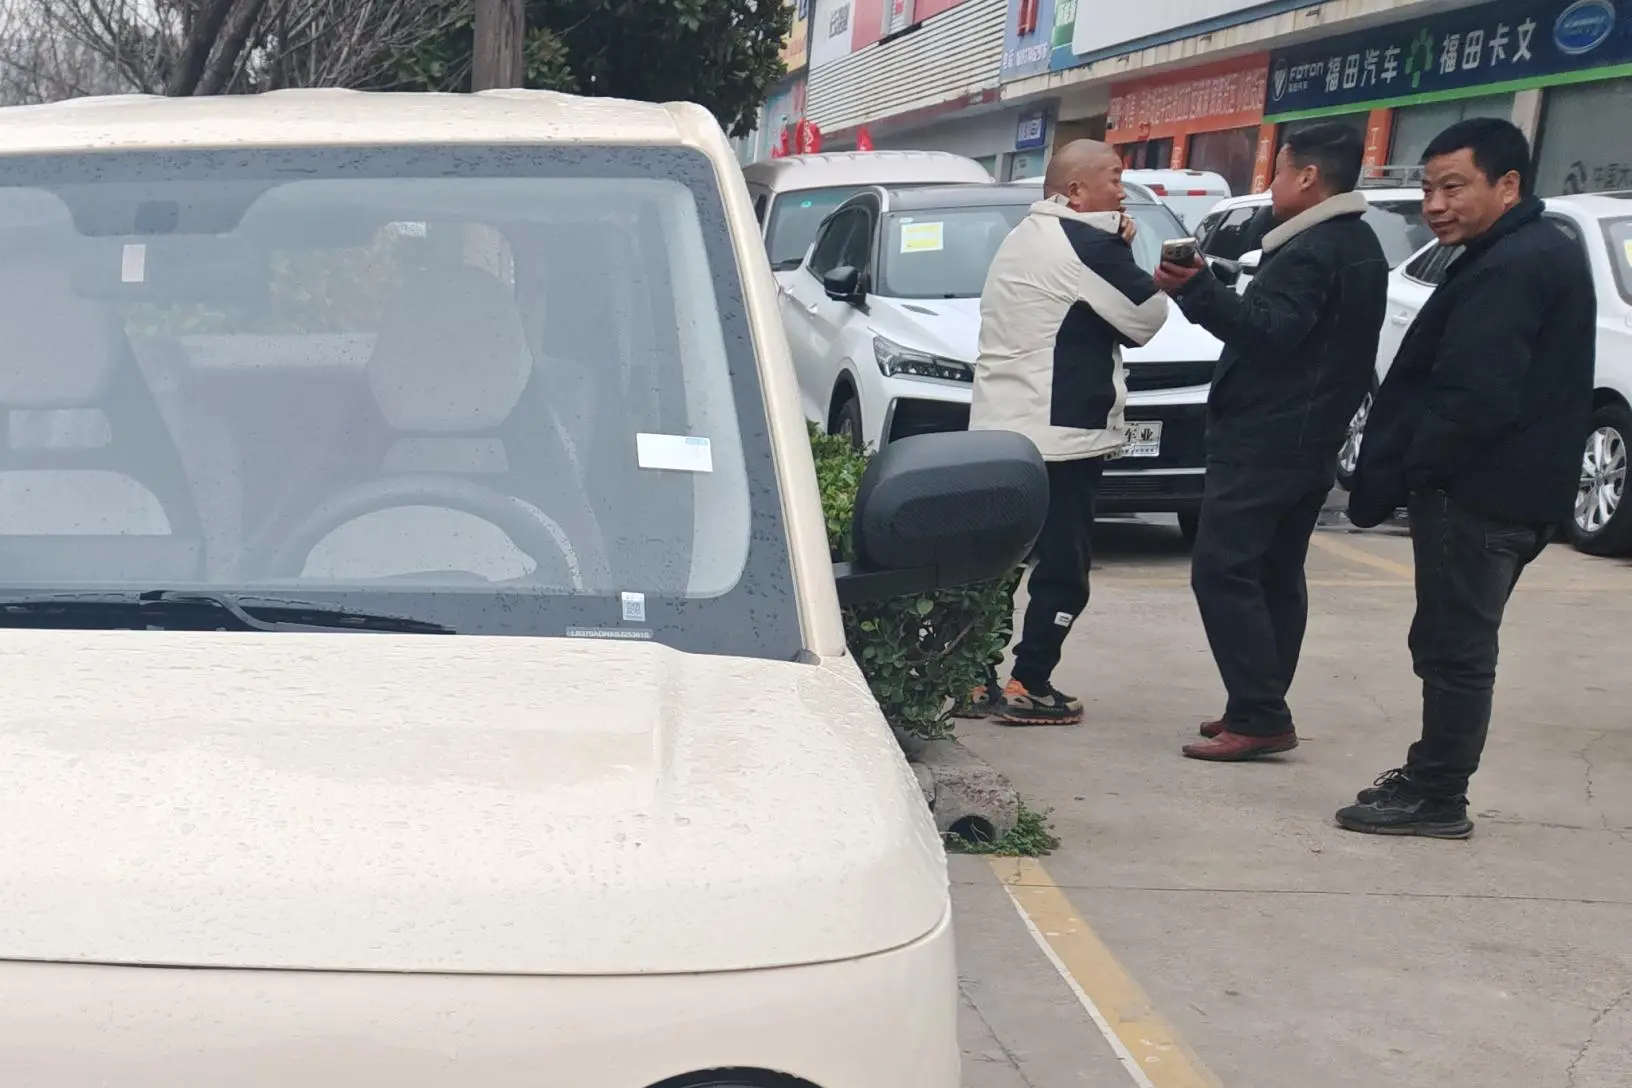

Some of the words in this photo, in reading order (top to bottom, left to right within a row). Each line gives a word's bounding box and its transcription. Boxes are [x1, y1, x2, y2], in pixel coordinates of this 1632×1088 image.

[1325, 45, 1401, 93] 福田汽车
[1439, 17, 1537, 75] 福田卡文
